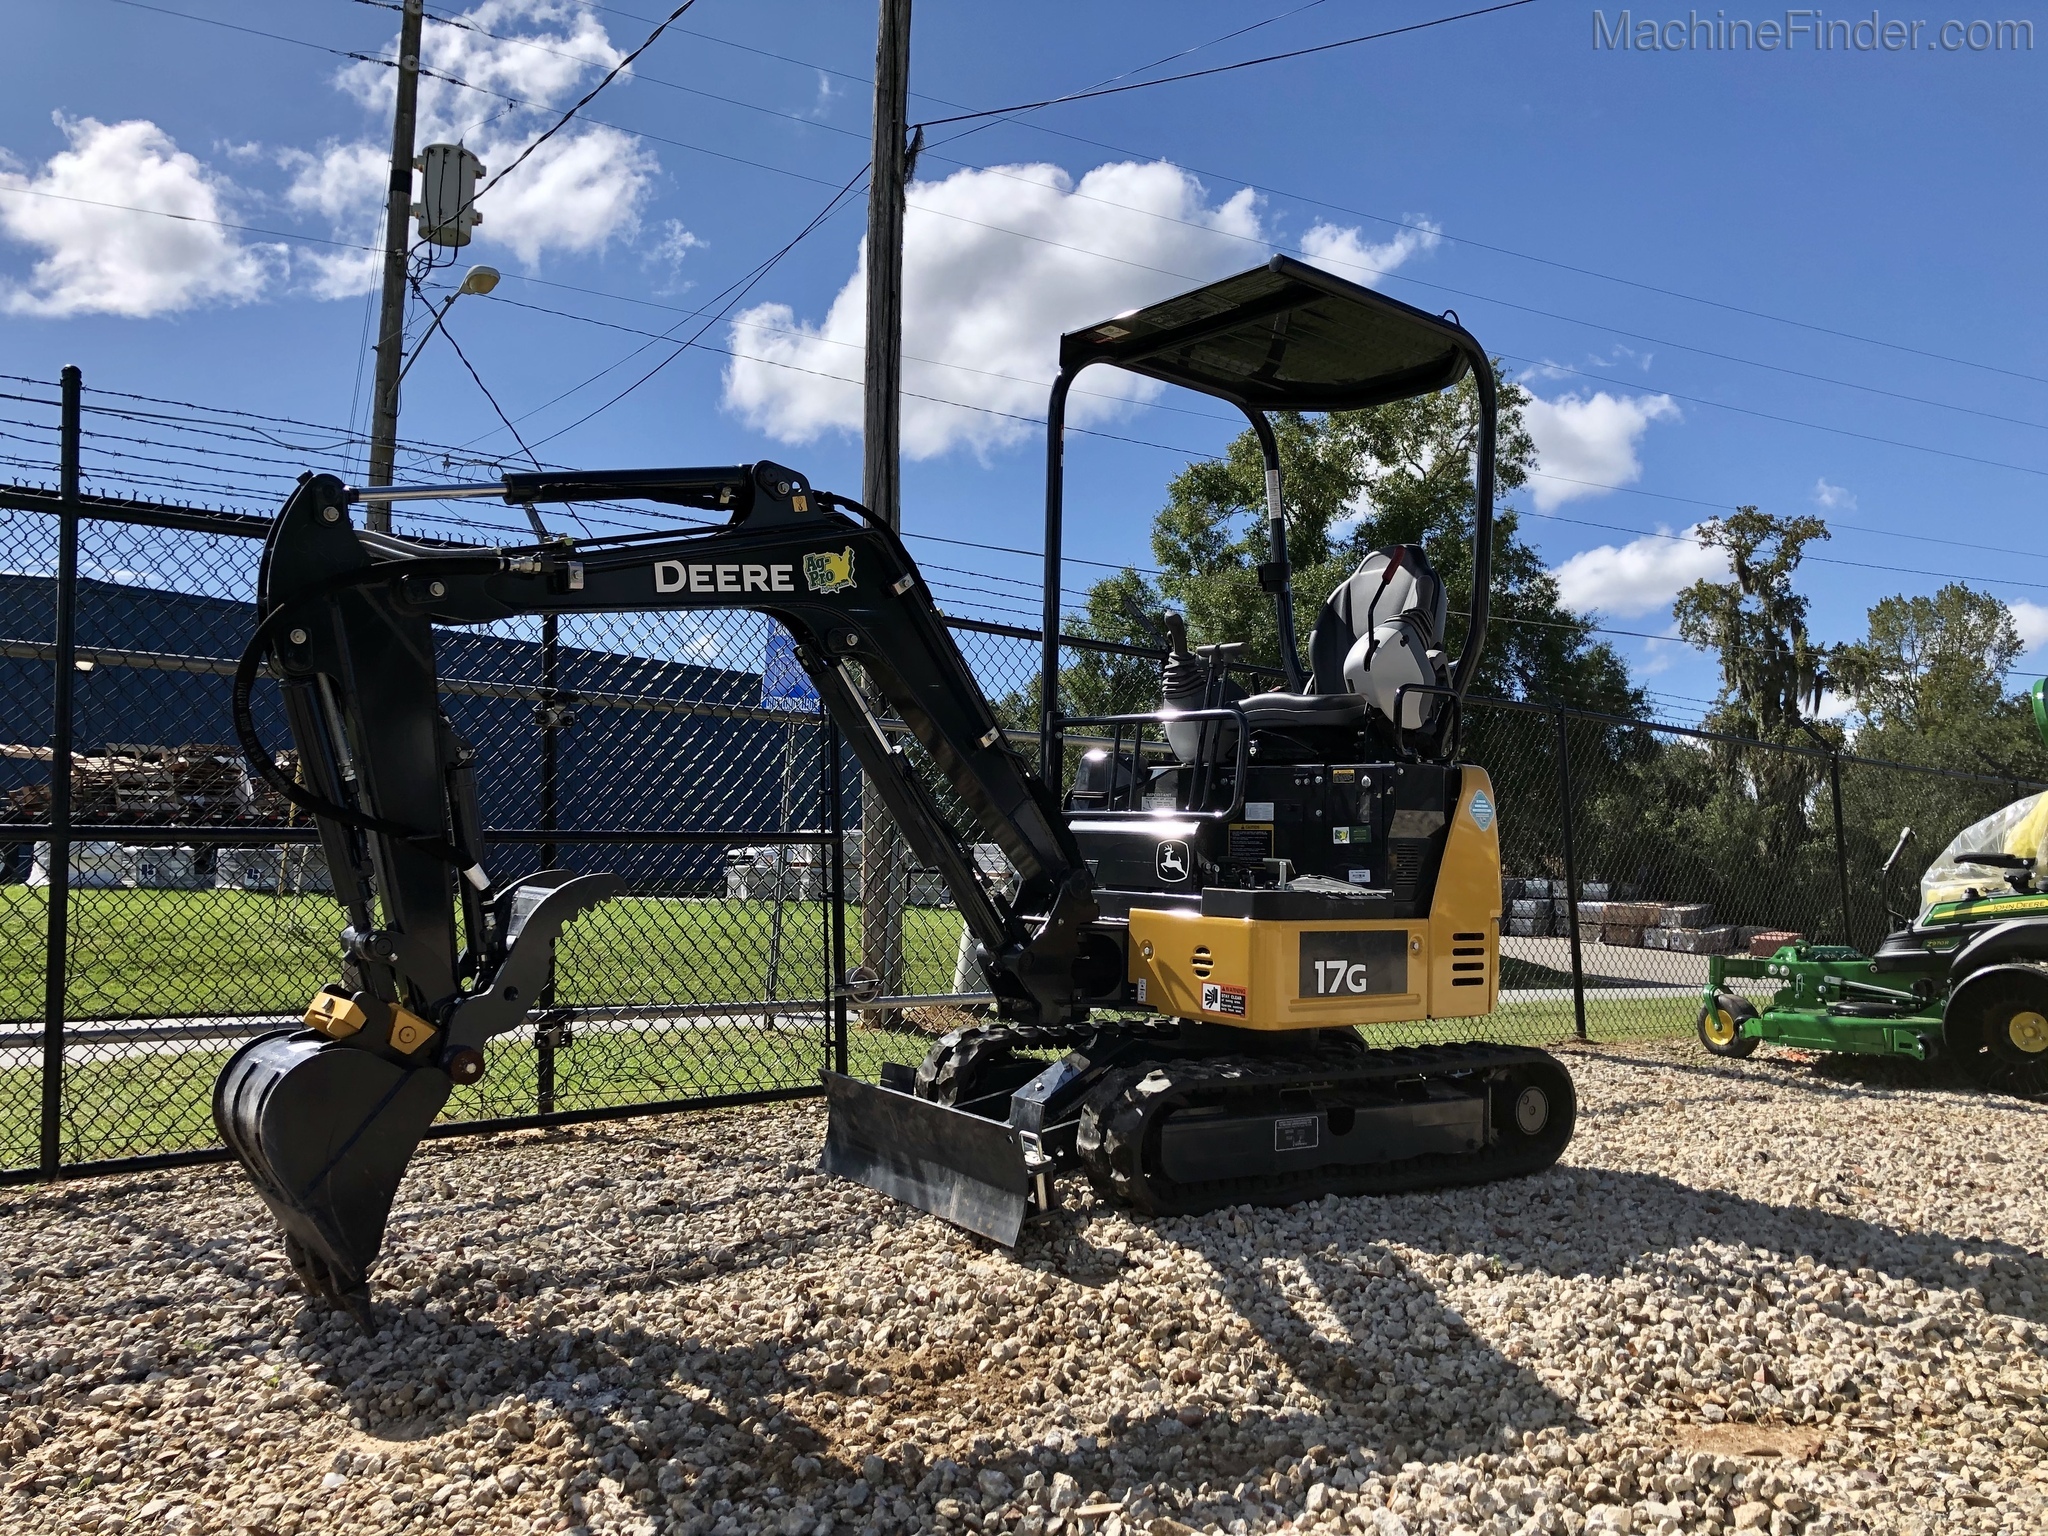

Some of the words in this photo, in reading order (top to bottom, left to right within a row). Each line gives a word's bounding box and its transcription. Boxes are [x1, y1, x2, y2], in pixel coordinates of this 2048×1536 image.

[654, 559, 795, 593] DEERE
[809, 570, 835, 587] Pro
[2015, 901, 2046, 909] DEERE
[1314, 960, 1367, 994] 17G
